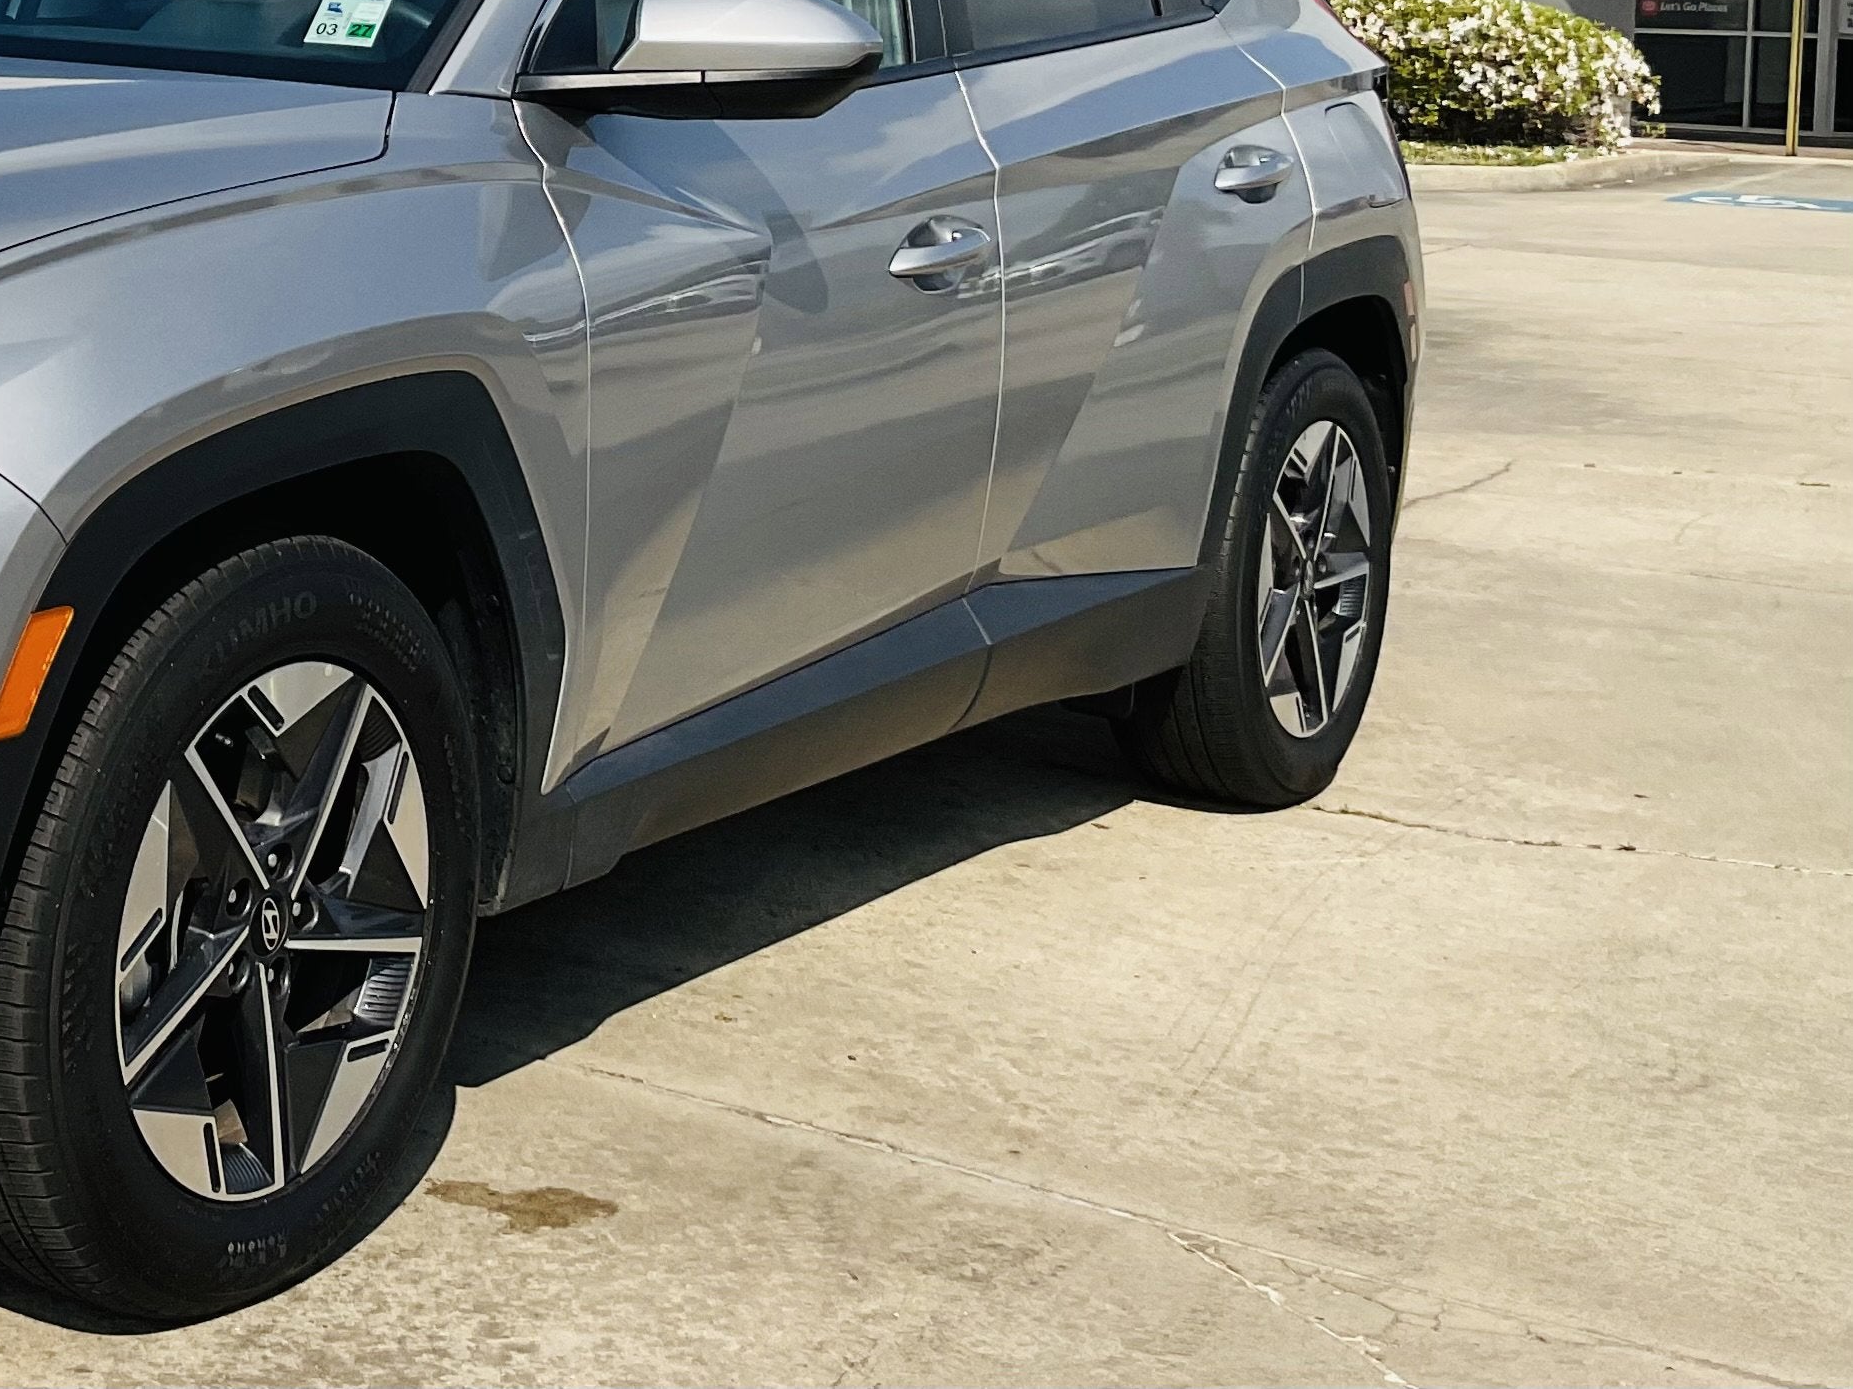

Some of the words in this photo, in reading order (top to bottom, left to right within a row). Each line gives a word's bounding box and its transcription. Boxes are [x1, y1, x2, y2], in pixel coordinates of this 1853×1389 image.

[1683, 1, 1697, 11] Go
[316, 22, 338, 36] 03
[348, 23, 375, 37] 27
